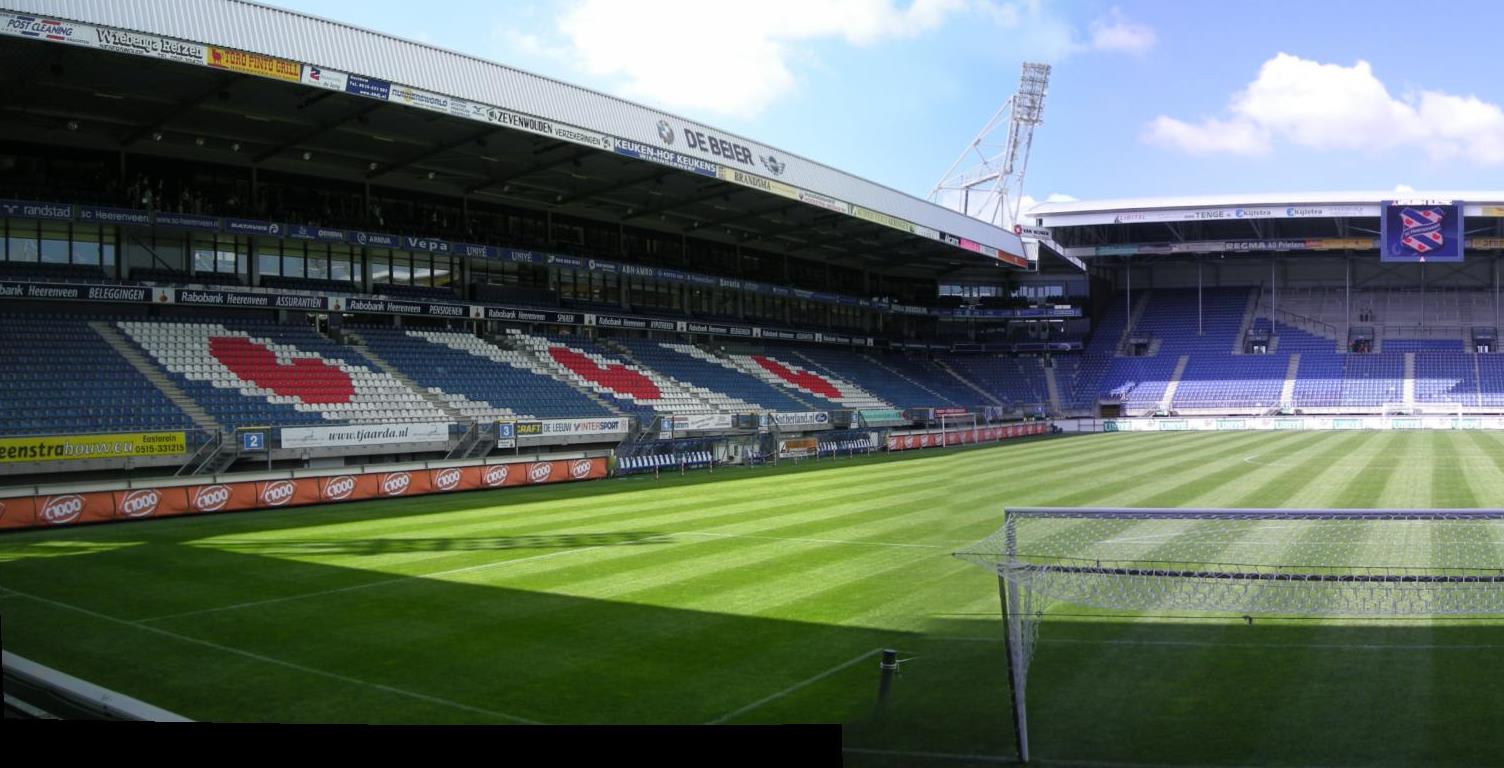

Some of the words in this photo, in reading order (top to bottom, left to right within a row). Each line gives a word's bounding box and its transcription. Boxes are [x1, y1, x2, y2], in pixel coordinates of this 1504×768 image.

[7, 19, 29, 31] POST
[31, 22, 73, 36] CLEANING
[225, 50, 247, 66] TORO
[497, 110, 552, 134] ZEVENWOLDEN
[555, 128, 601, 146] VERZEKERINGEN
[615, 138, 677, 162] KEUKEN-HOF
[677, 154, 717, 172] KEUKENS
[684, 128, 709, 152] DE
[708, 136, 755, 167] BEIER
[734, 171, 771, 191] BRANDSMA
[23, 204, 71, 218] randstad
[80, 209, 92, 218] sc
[95, 209, 149, 223] Heerenveen
[1196, 210, 1224, 219] TENGE
[408, 237, 448, 252] Vepa
[511, 251, 533, 262] UNIVÉ
[28, 286, 78, 298] Heerenveen
[88, 287, 145, 300] BELEGGINGEN
[181, 291, 223, 304] Rabobank
[227, 293, 268, 305] Heerenveen
[350, 300, 385, 310] Rabobank
[387, 302, 421, 313] Heerenveen
[488, 309, 516, 319] Rabobank
[503, 426, 510, 435] 3
[543, 423, 552, 432] DE
[552, 422, 572, 432] LEEUW
[580, 421, 619, 431] INTERSPORT
[142, 434, 177, 443] Easterein
[250, 435, 258, 447] 2
[328, 427, 409, 442] www.tjaarda.nl
[135, 443, 184, 454] 0515-331215
[438, 470, 460, 488] C1000
[487, 467, 507, 483] C1000
[327, 478, 354, 496] C1000
[384, 475, 409, 493] C1000
[197, 488, 228, 508] C1000
[264, 483, 293, 502] C1000
[45, 498, 81, 520] C1000
[124, 492, 158, 513] C1000
